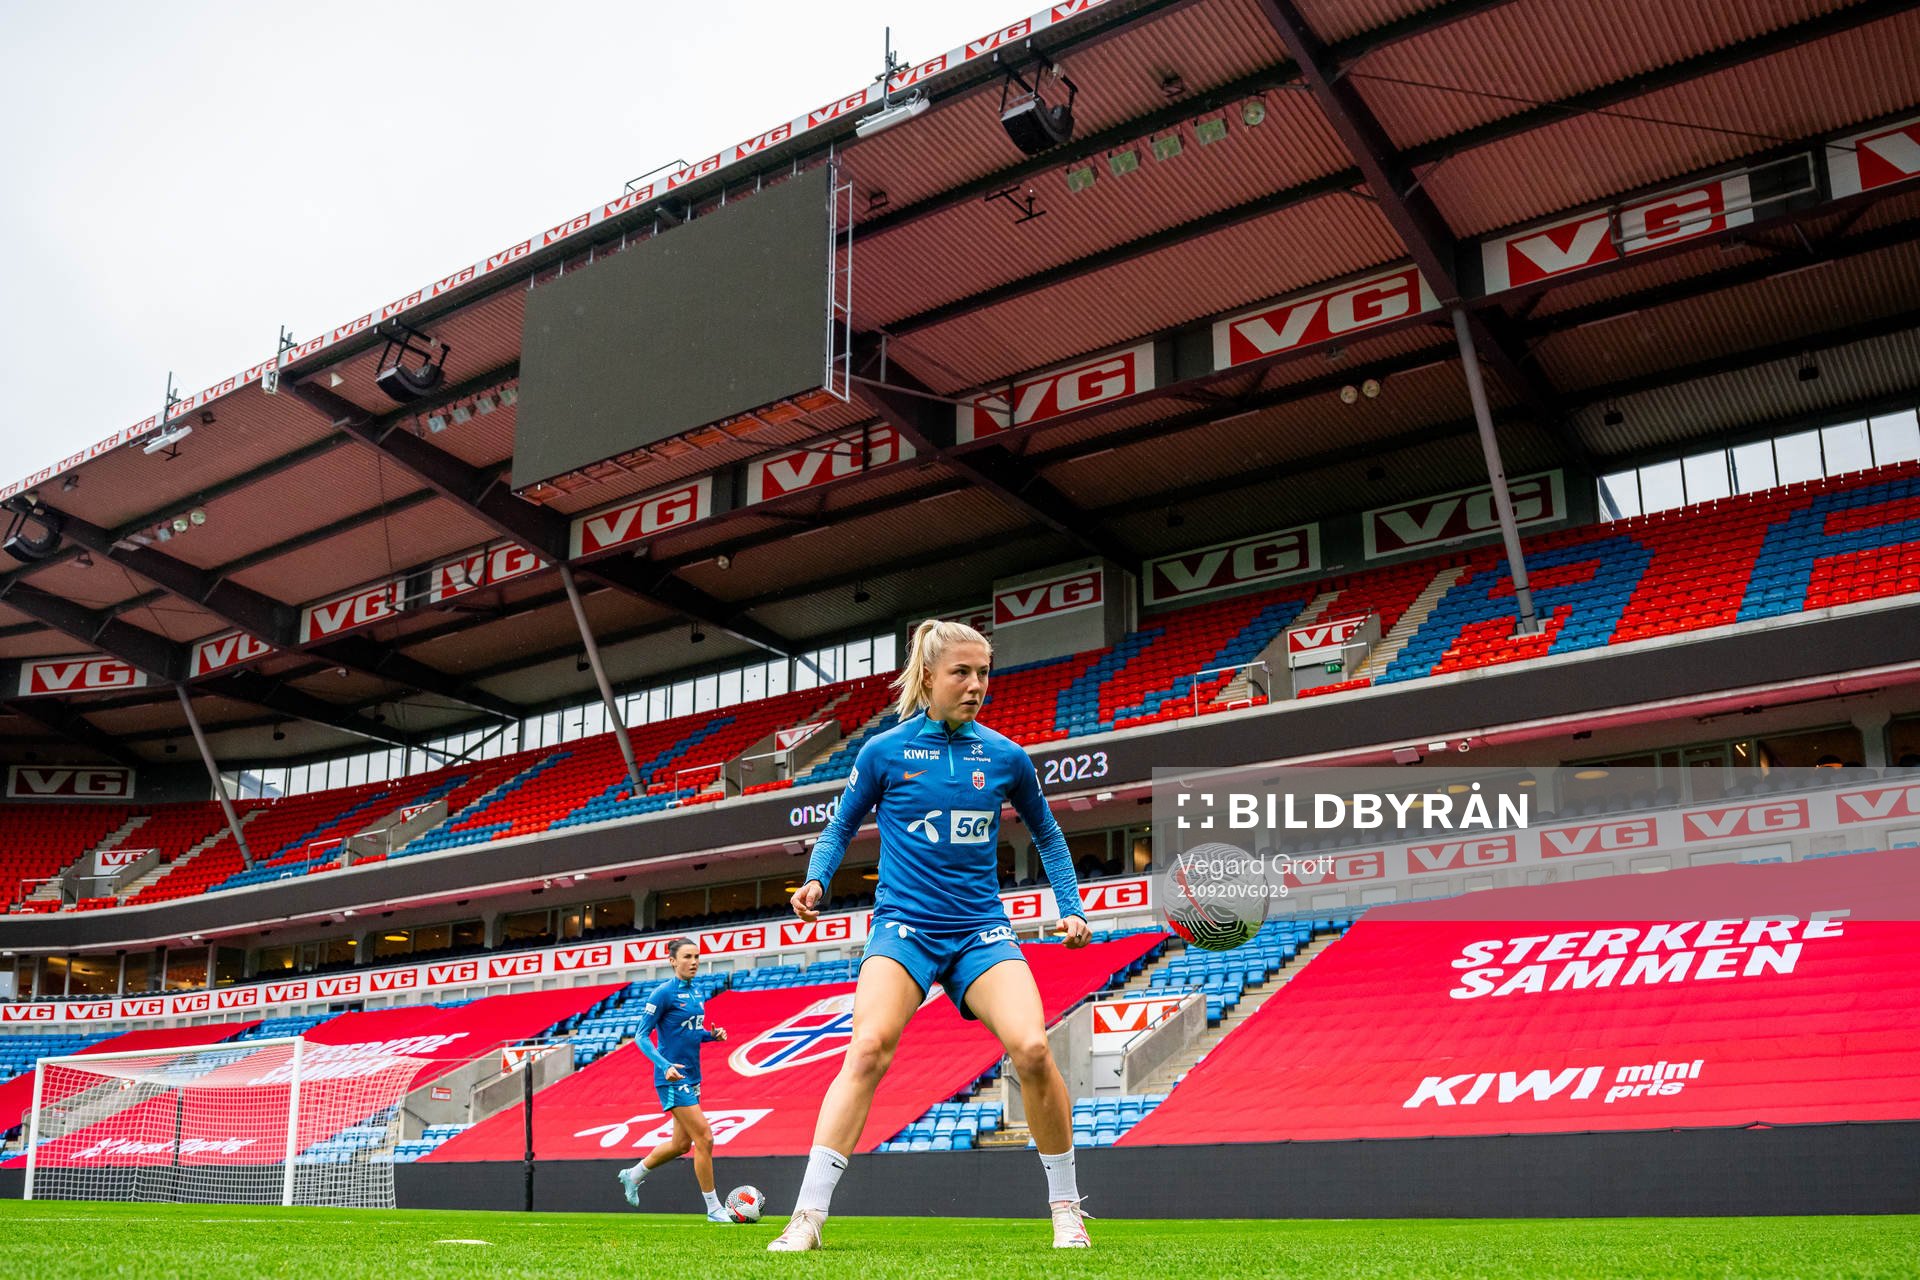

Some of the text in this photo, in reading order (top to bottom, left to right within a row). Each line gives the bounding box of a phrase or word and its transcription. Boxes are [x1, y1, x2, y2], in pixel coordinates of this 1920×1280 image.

[967, 19, 1028, 55] VG
[889, 58, 946, 92] VG
[811, 93, 866, 124] VG
[738, 125, 790, 155] VG
[670, 156, 720, 185] VG
[606, 186, 652, 215] VG
[545, 214, 589, 243] VG
[1511, 190, 1713, 274] VG
[489, 243, 529, 269] VG
[434, 268, 474, 294] VG
[384, 292, 420, 317] VG
[1233, 277, 1410, 355] VG
[335, 316, 370, 340] VG
[289, 337, 322, 361] VG
[245, 360, 276, 382] VG
[204, 380, 234, 402] VG
[979, 359, 1126, 429] VG
[167, 399, 193, 420] VG
[128, 418, 154, 438] VG
[93, 436, 118, 456] VG
[767, 429, 892, 492] VG
[586, 491, 692, 548] VG
[1379, 482, 1543, 545] VG
[446, 544, 536, 590] VG
[1157, 535, 1300, 592] VG
[313, 587, 393, 634] VG
[1000, 577, 1094, 618] VG
[37, 661, 131, 690] VG
[904, 749, 928, 760] KIWI
[20, 770, 122, 794] VG
[790, 751, 1109, 827] onsd 2023
[1841, 788, 1920, 818] V
[956, 817, 989, 838] 5G
[1688, 803, 1801, 837] VG
[1544, 821, 1650, 854] VG
[1412, 838, 1512, 870] VG
[1288, 855, 1380, 886] VG
[703, 929, 762, 952] VG
[783, 917, 847, 943] VG
[1451, 909, 1850, 969] STERKERE
[491, 956, 541, 976] VG
[557, 947, 609, 969] VG
[1450, 943, 1802, 1000] SAMMEN
[318, 977, 360, 996] VG
[373, 970, 415, 990] VG
[430, 963, 477, 984] VG
[175, 996, 209, 1012] VG
[220, 989, 256, 1007] VG
[267, 983, 306, 1002] VG
[5, 1006, 52, 1020] VG
[69, 1003, 111, 1018] VG
[123, 1001, 162, 1016] VG
[1402, 1059, 1704, 1108] KIWI mini
[1604, 1080, 1686, 1104] pris
